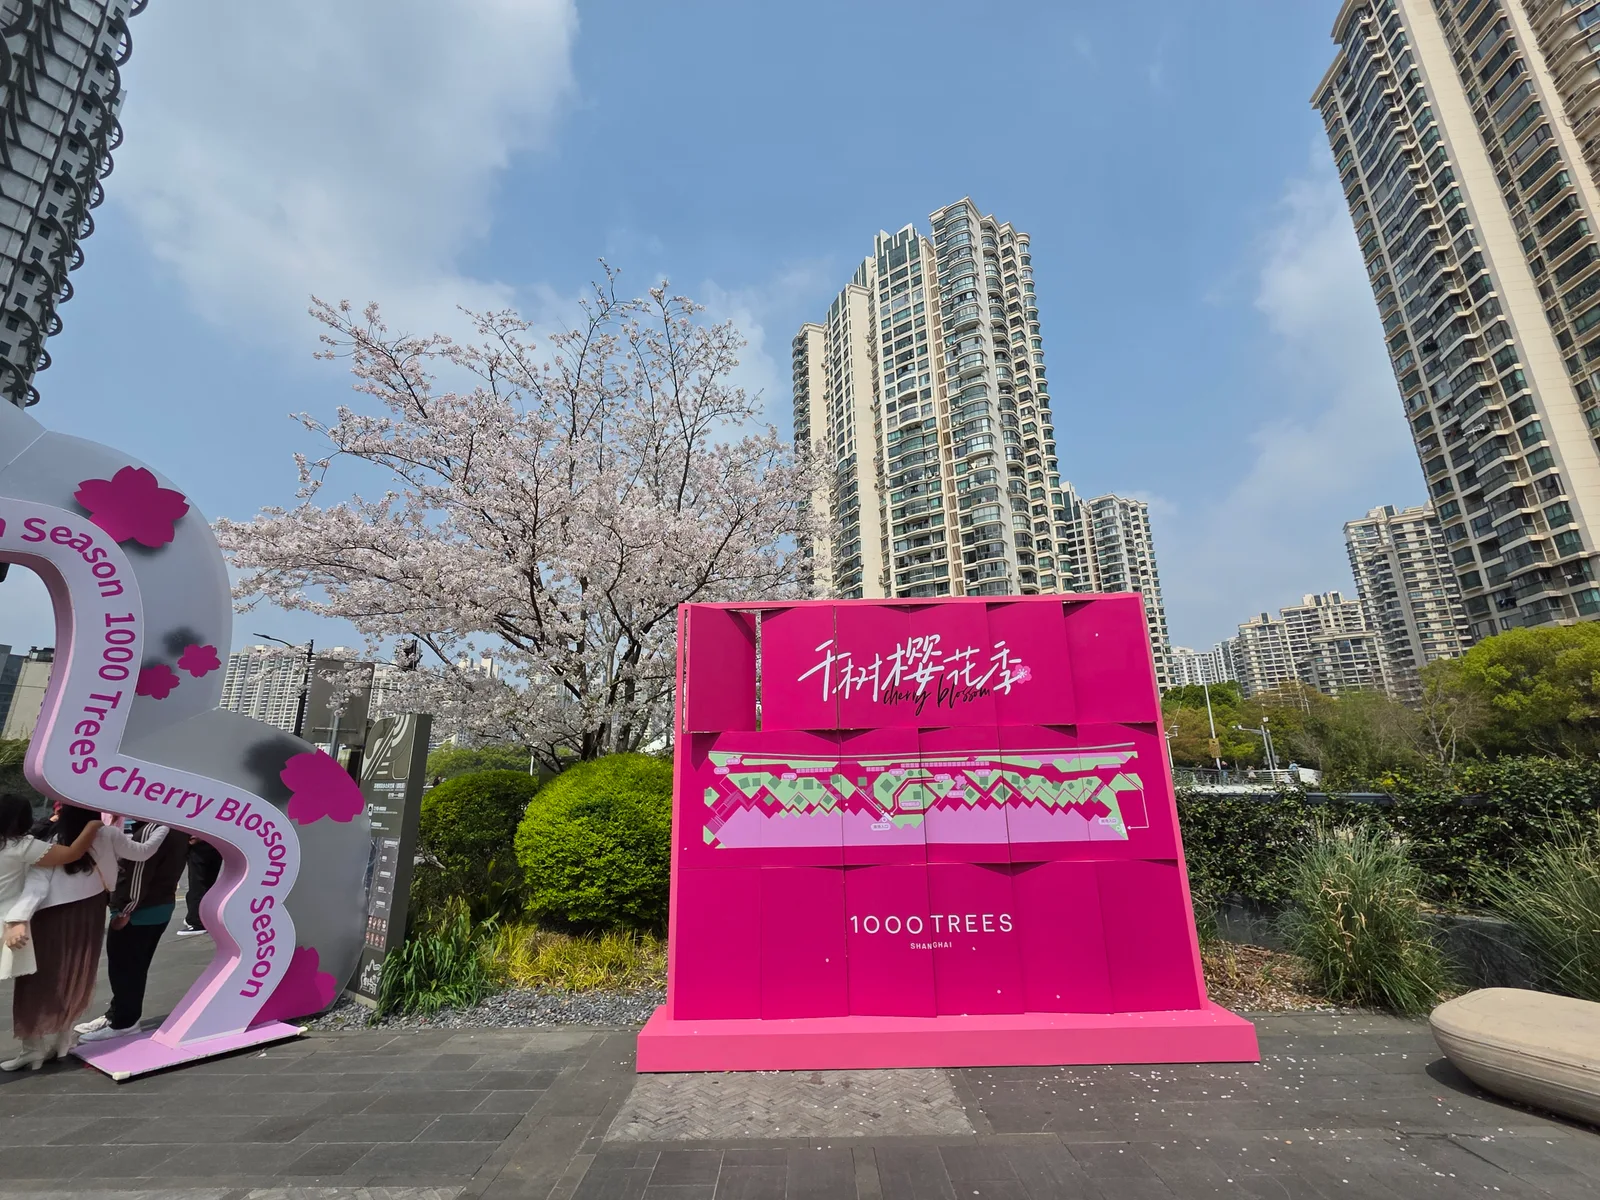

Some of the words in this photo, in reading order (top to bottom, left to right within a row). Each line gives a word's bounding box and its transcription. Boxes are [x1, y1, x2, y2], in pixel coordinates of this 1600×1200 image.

[21, 518, 124, 597] Season
[98, 613, 135, 681] 1000
[798, 634, 1022, 702] 千树樱花季
[883, 675, 931, 716] cherry
[937, 673, 991, 709] blossom
[69, 691, 122, 774] Trees
[99, 766, 215, 818] Cherry
[215, 798, 287, 887] Blossom
[240, 895, 276, 998] Season
[850, 915, 924, 935] 1000
[930, 914, 1013, 933] TREES
[910, 941, 953, 950] SHANGHAI
